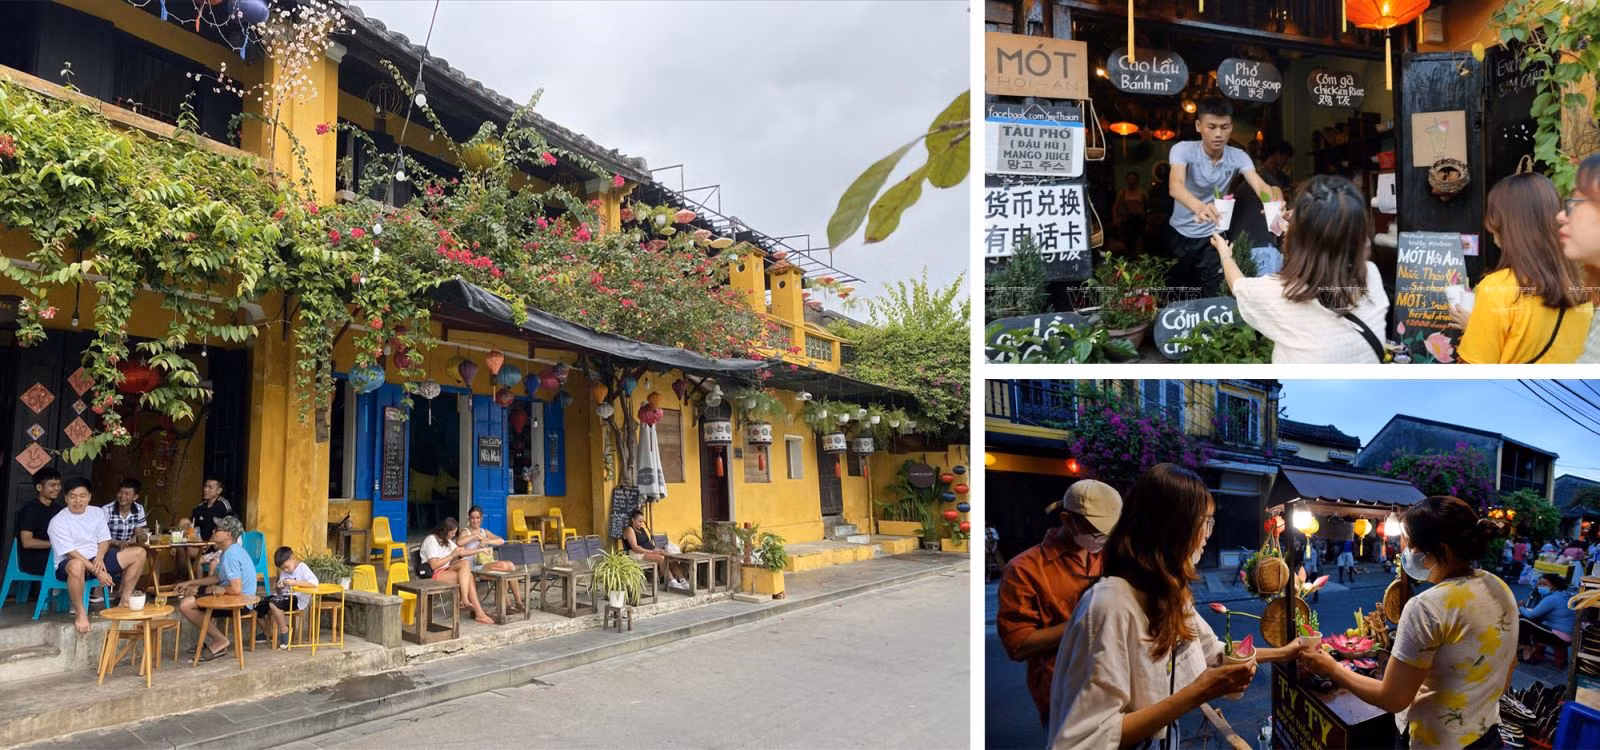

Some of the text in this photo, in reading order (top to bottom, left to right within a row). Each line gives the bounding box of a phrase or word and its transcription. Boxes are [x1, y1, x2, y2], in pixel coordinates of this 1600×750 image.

[997, 43, 1077, 79] MÓT
[1121, 74, 1151, 91] Bánh
[1224, 74, 1282, 93] Noodle soup
[1003, 150, 1071, 162] MANGO JUICE
[1007, 160, 1066, 172] 망고 주스
[985, 188, 1081, 219] 货币兑换
[985, 221, 1082, 254] 有电话卡
[1398, 247, 1426, 265] MÓT
[1303, 699, 1334, 747] TY
